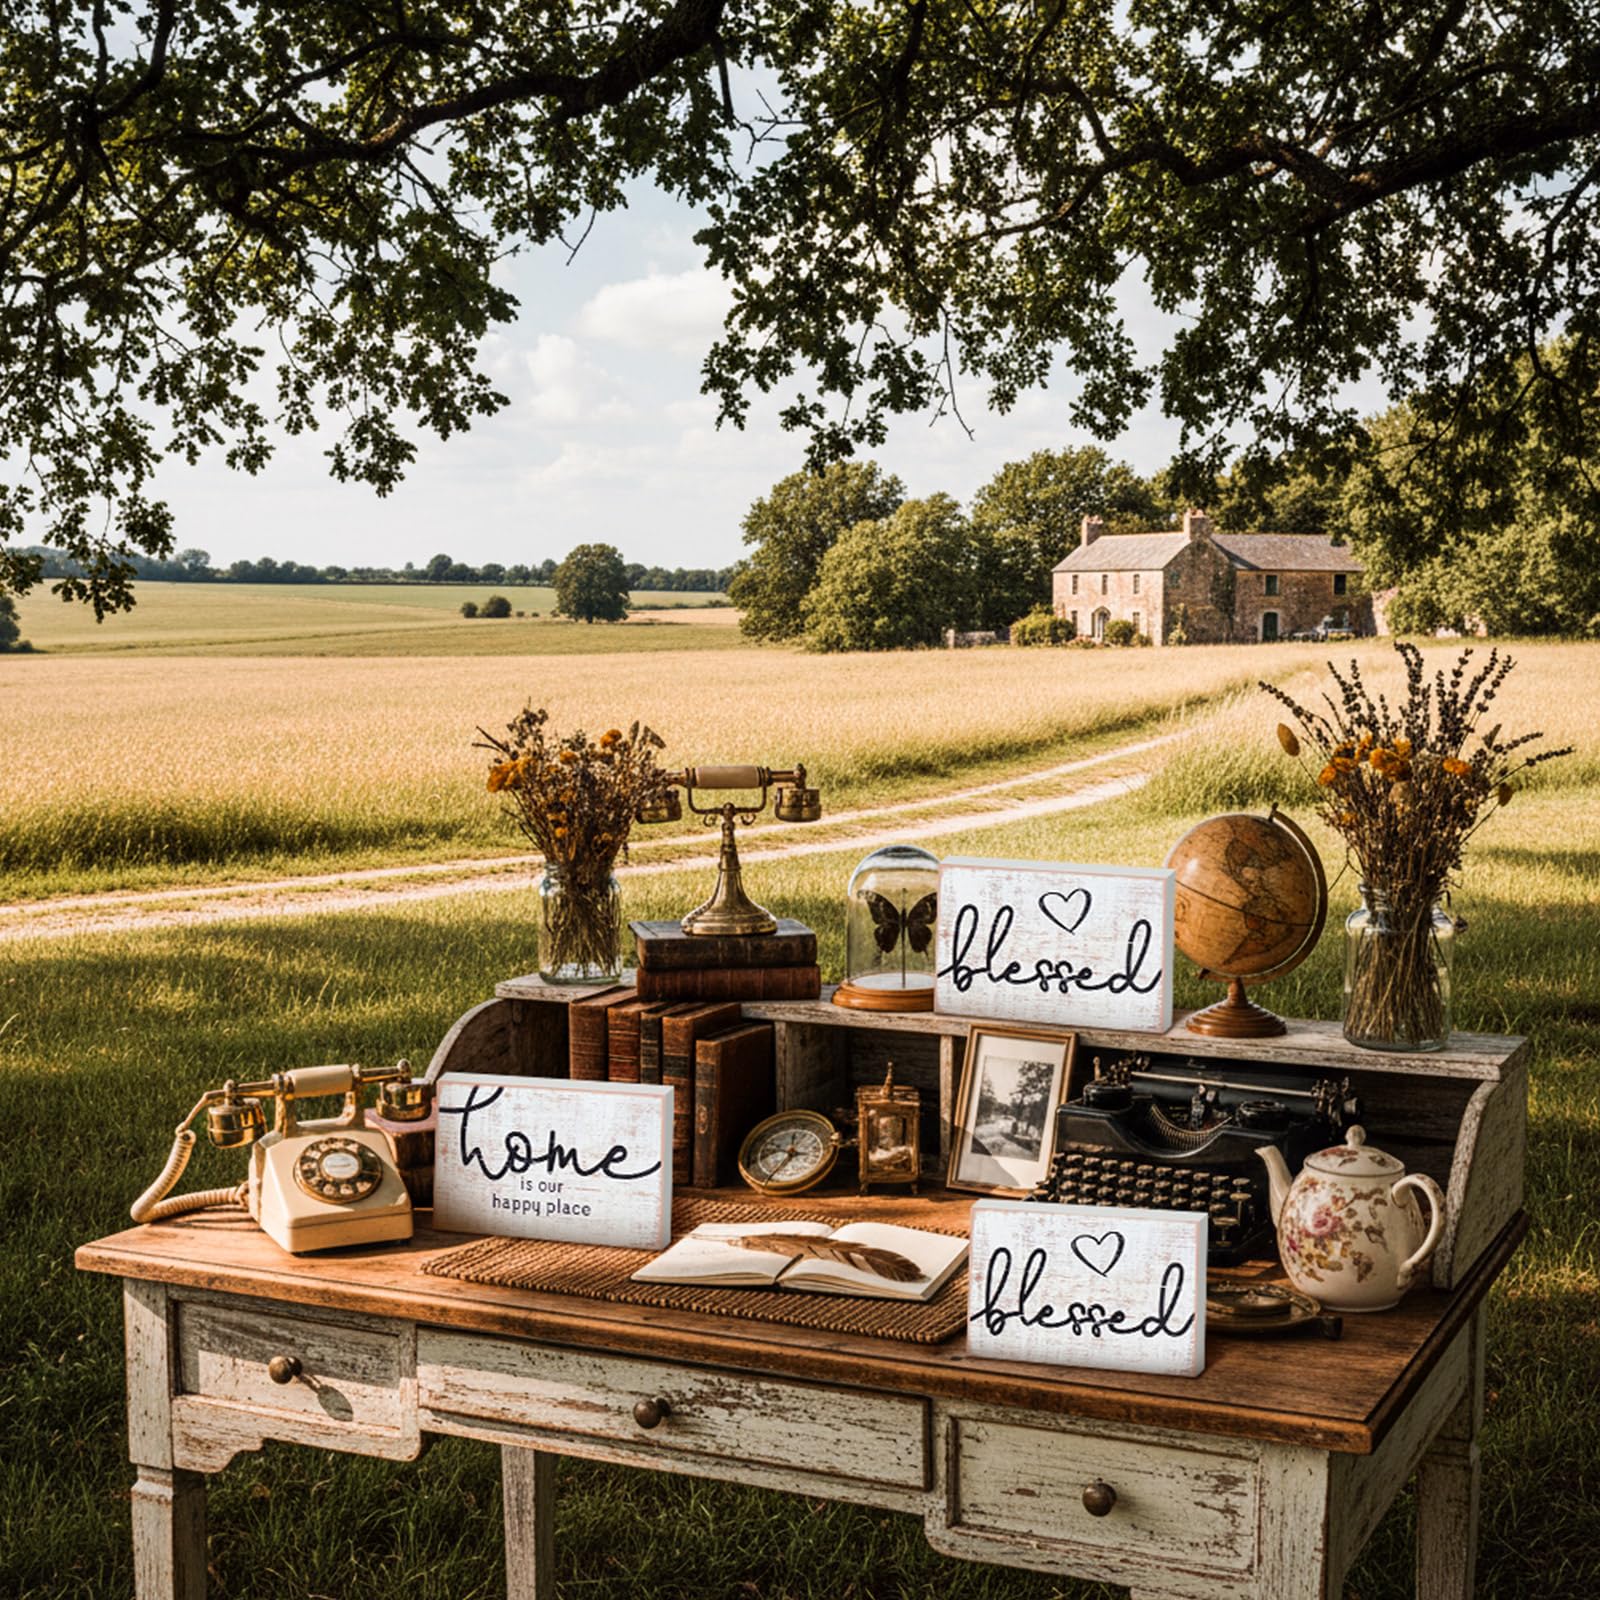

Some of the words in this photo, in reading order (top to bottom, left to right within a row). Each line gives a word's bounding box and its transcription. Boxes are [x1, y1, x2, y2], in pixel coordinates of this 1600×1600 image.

[937, 903, 1162, 993] blessed
[439, 1085, 662, 1181] home
[492, 1194, 541, 1216] happy
[546, 1198, 592, 1217] place
[520, 1178, 533, 1192] is
[538, 1182, 564, 1193] our
[970, 1247, 1195, 1338] blessed
